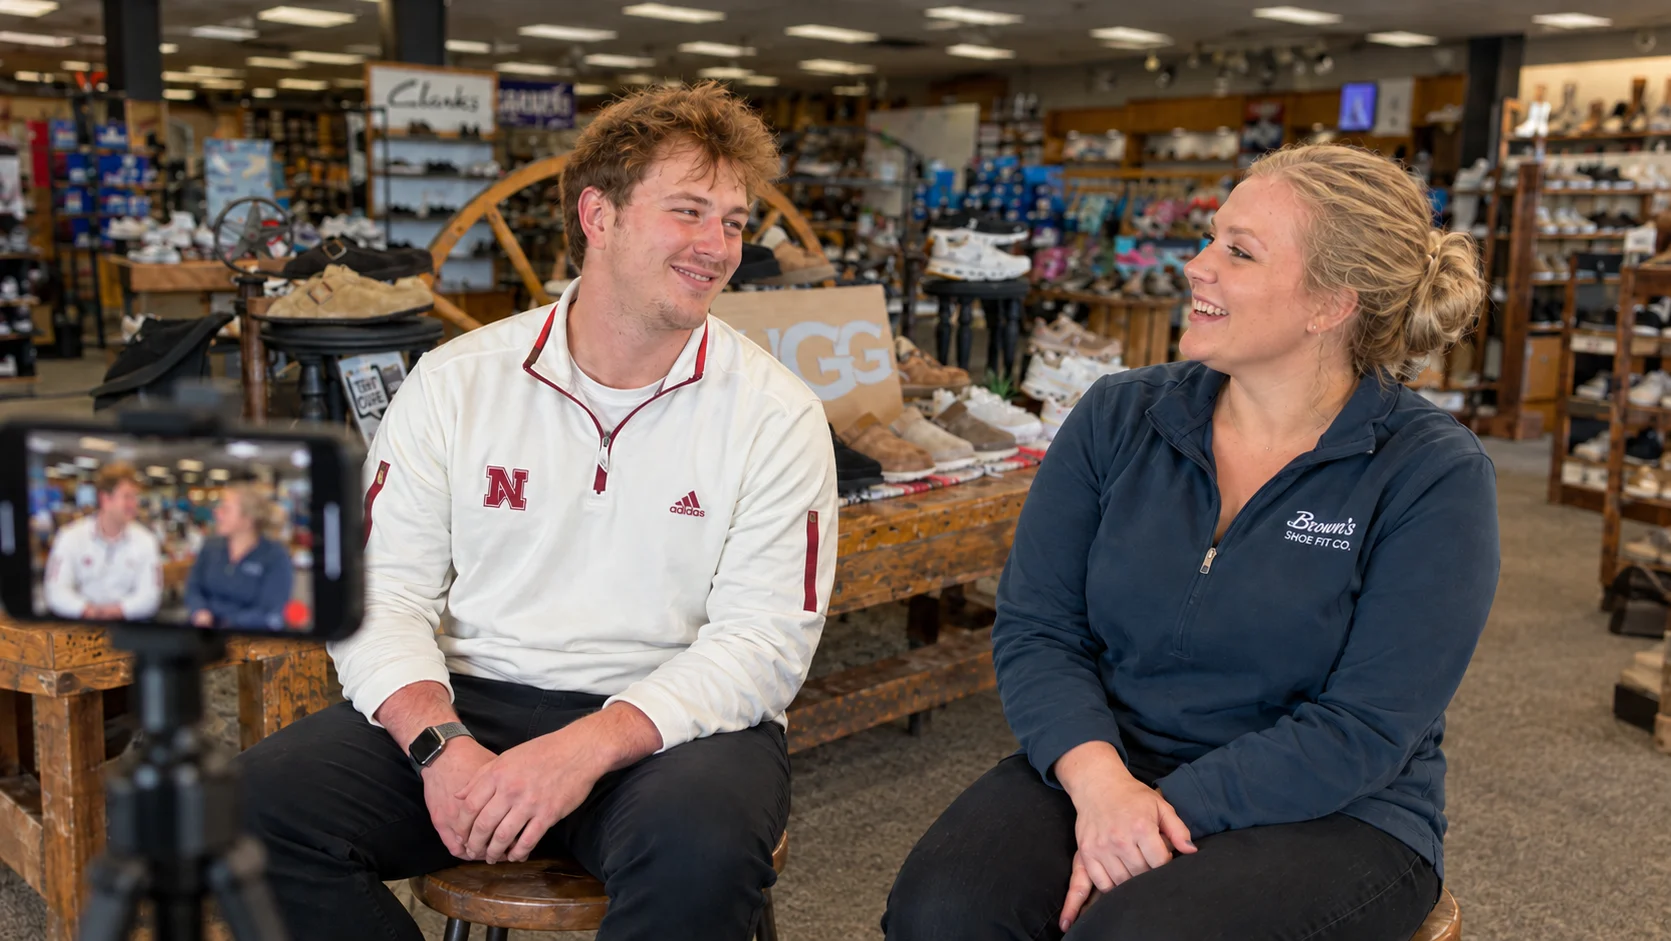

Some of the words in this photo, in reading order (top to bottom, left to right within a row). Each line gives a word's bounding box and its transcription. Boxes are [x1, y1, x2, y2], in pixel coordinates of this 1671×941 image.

[386, 78, 480, 113] Clarks
[738, 320, 893, 402] GG
[483, 465, 529, 511] N
[669, 504, 706, 518] adidas
[1286, 510, 1357, 536] Brown's
[1284, 530, 1314, 545] SHOE
[1314, 536, 1332, 547] FIT
[1332, 539, 1351, 551] CO.
